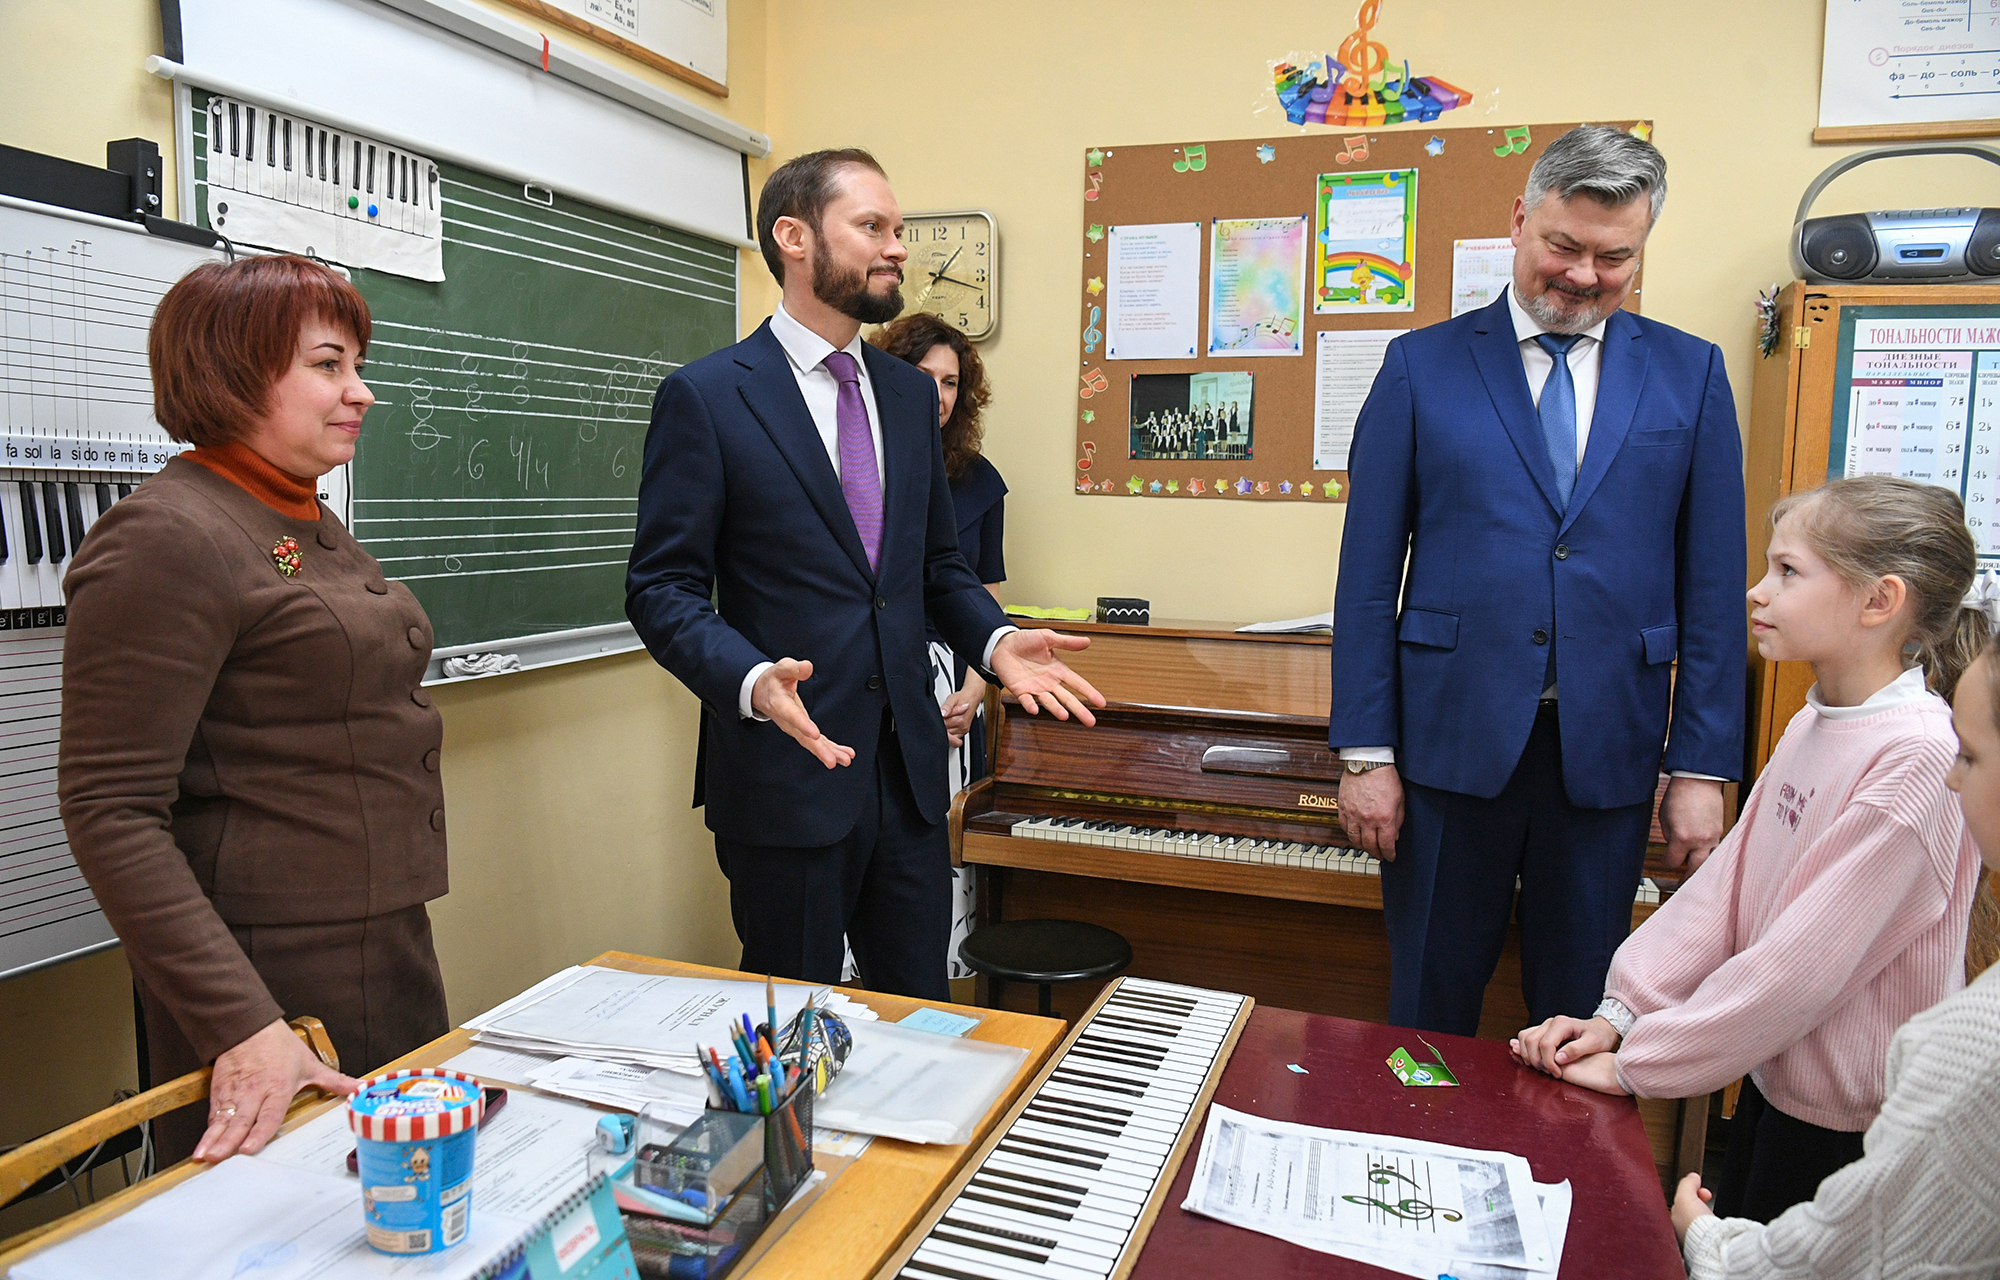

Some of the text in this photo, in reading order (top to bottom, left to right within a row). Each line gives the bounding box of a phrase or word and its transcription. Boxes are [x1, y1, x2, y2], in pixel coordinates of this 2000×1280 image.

[627, 20, 634, 29] as
[1939, 43, 1974, 51] диезов
[1889, 72, 1905, 82] фа
[1920, 71, 1935, 80] до
[909, 229, 919, 242] 11
[932, 226, 947, 241] 12
[961, 226, 965, 239] 1
[976, 242, 985, 256] 2
[976, 269, 985, 282] 3
[976, 295, 984, 309] 4
[959, 313, 968, 327] 5
[1870, 328, 1962, 344] ТОНАЛЬНОСТИ
[6, 443, 168, 464] fa sol la si do re mi fa sol
[468, 439, 488, 480] 6
[612, 447, 625, 478] 6
[1298, 794, 1338, 808] RÖNIS
